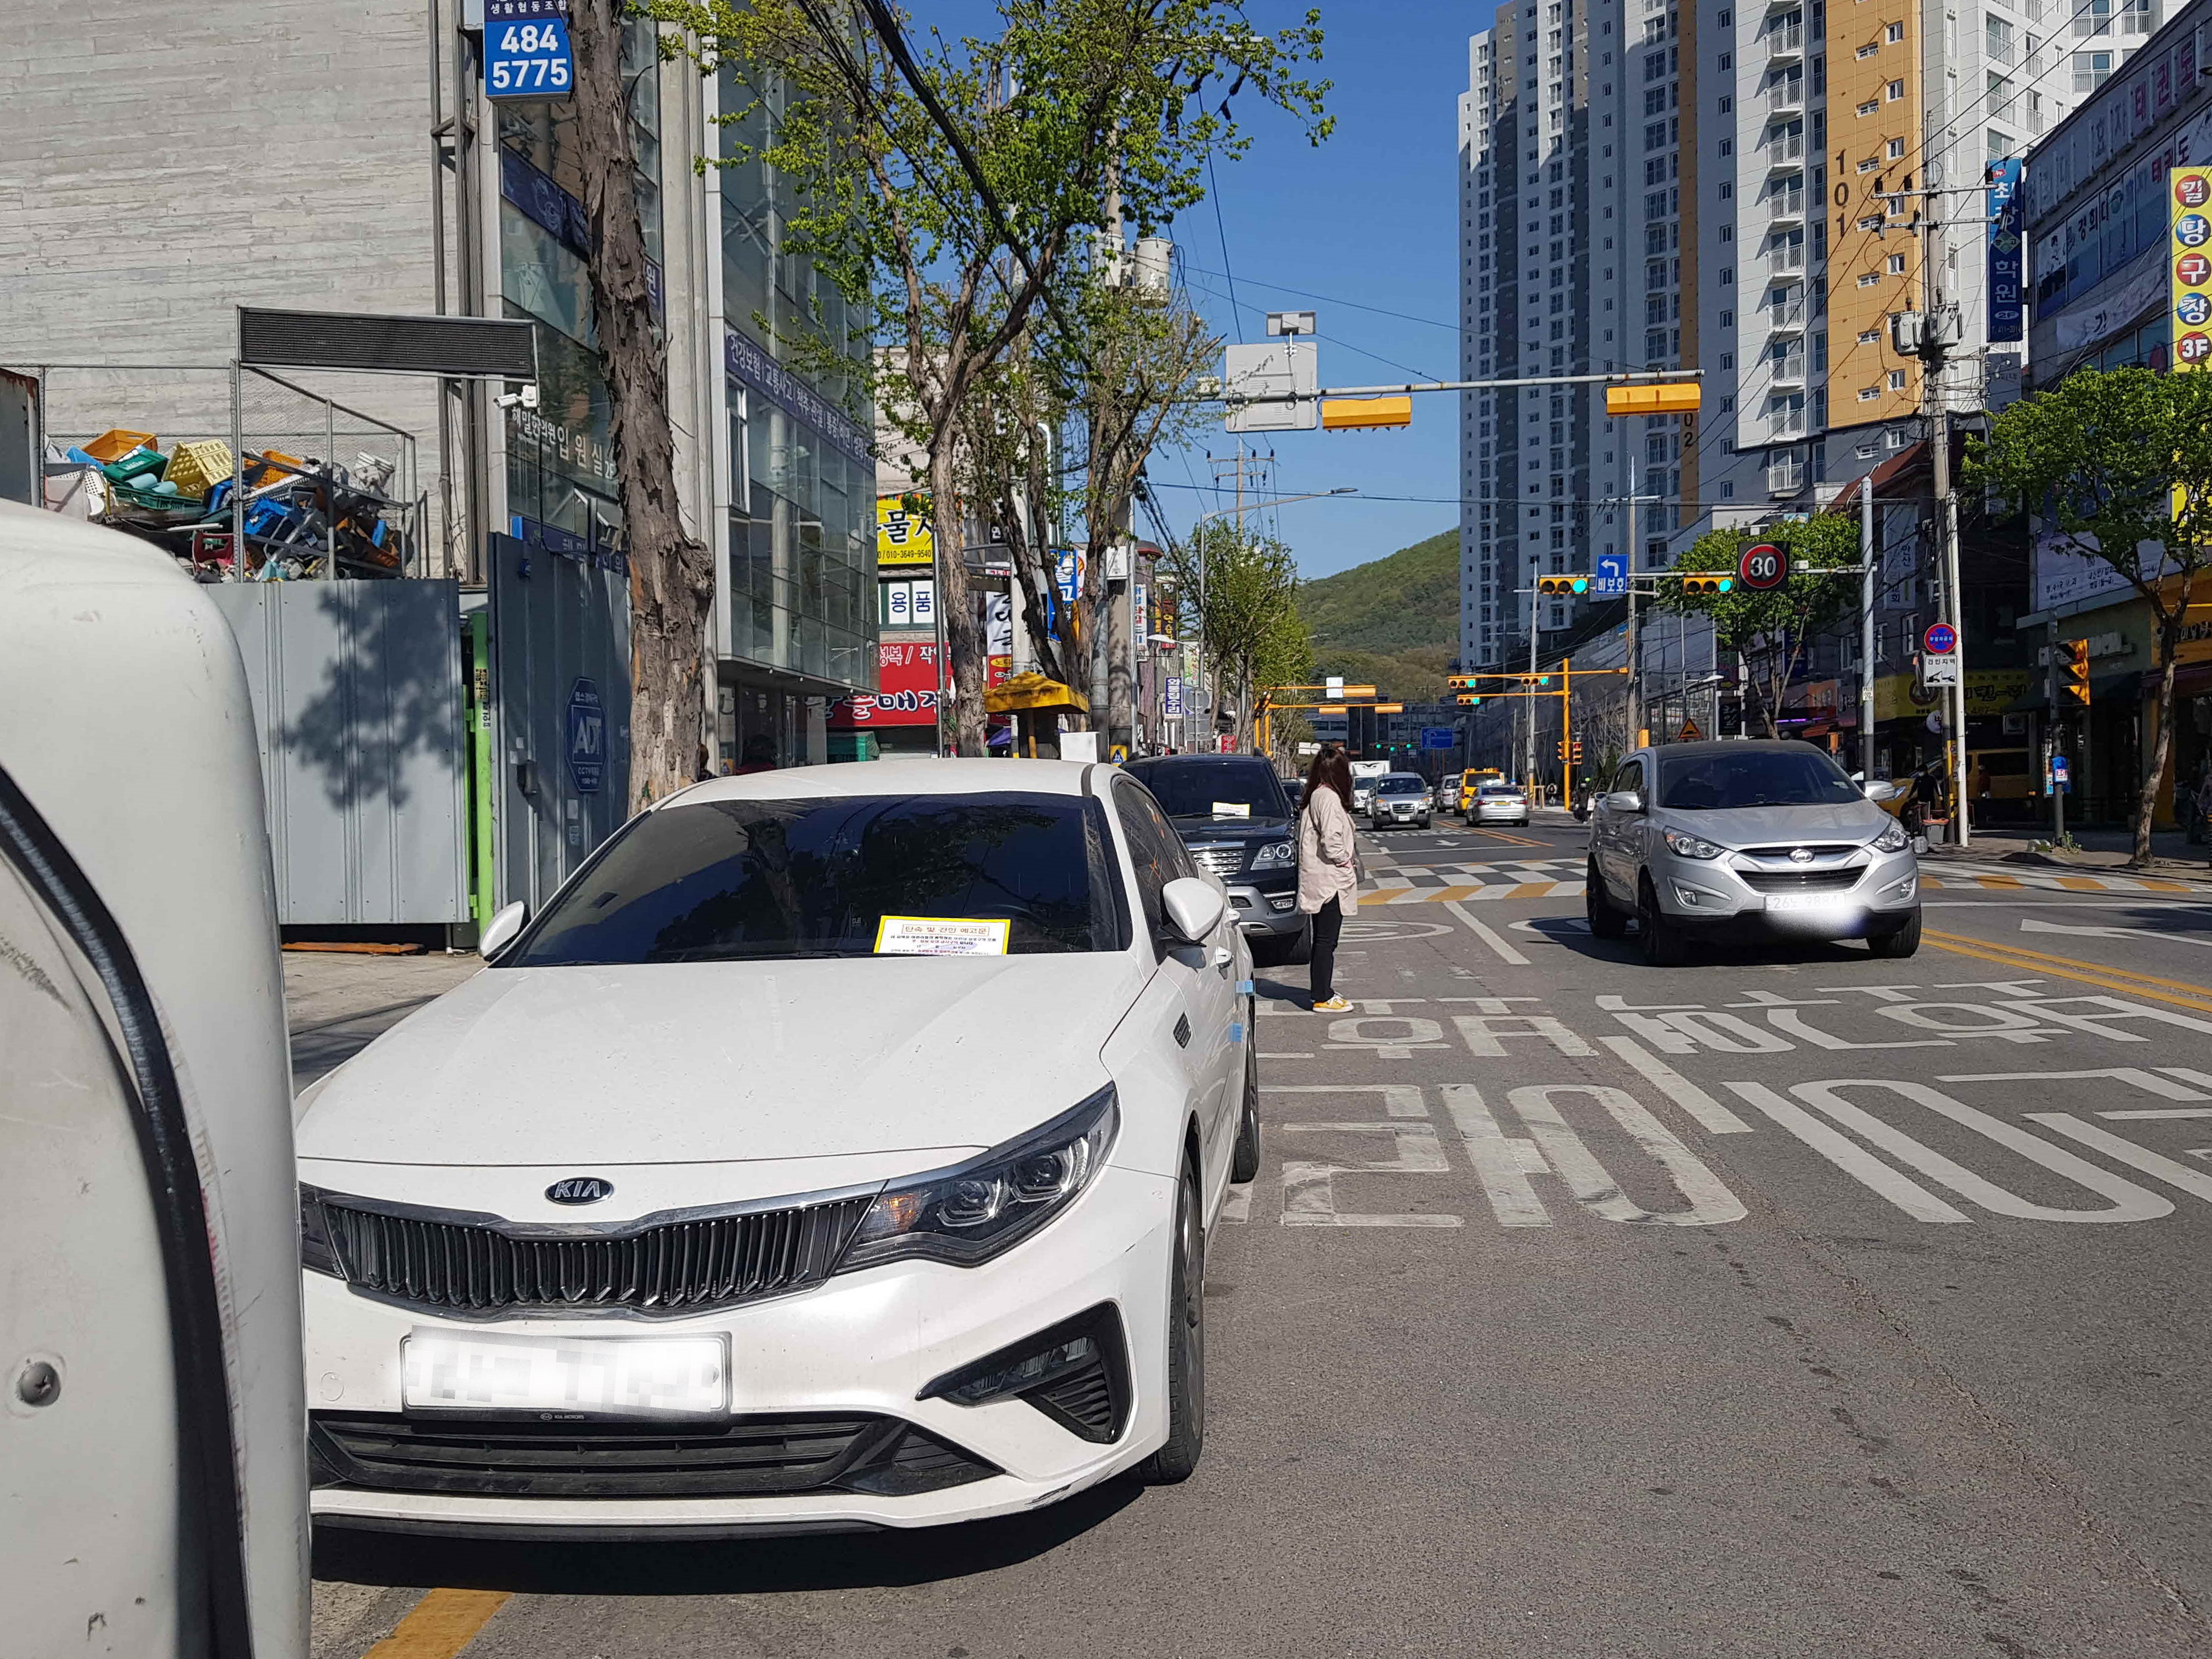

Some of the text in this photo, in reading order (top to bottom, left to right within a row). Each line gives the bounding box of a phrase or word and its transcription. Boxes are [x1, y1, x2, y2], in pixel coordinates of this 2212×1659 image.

[500, 24, 558, 53] 484
[493, 58, 568, 88] 5775
[1835, 149, 1849, 237] 101
[2181, 179, 2207, 324] 길당구장
[1995, 259, 2019, 303] 학원
[2181, 338, 2209, 358] 3F
[731, 336, 760, 382] 건강보험
[765, 364, 793, 400] 교통사고
[557, 426, 603, 477] 입원실
[887, 549, 932, 558] 010-3649-9540
[1750, 556, 1776, 577] 30
[1598, 578, 1624, 592] 비보호
[891, 591, 932, 612] 용품
[554, 1180, 601, 1198] KIA
